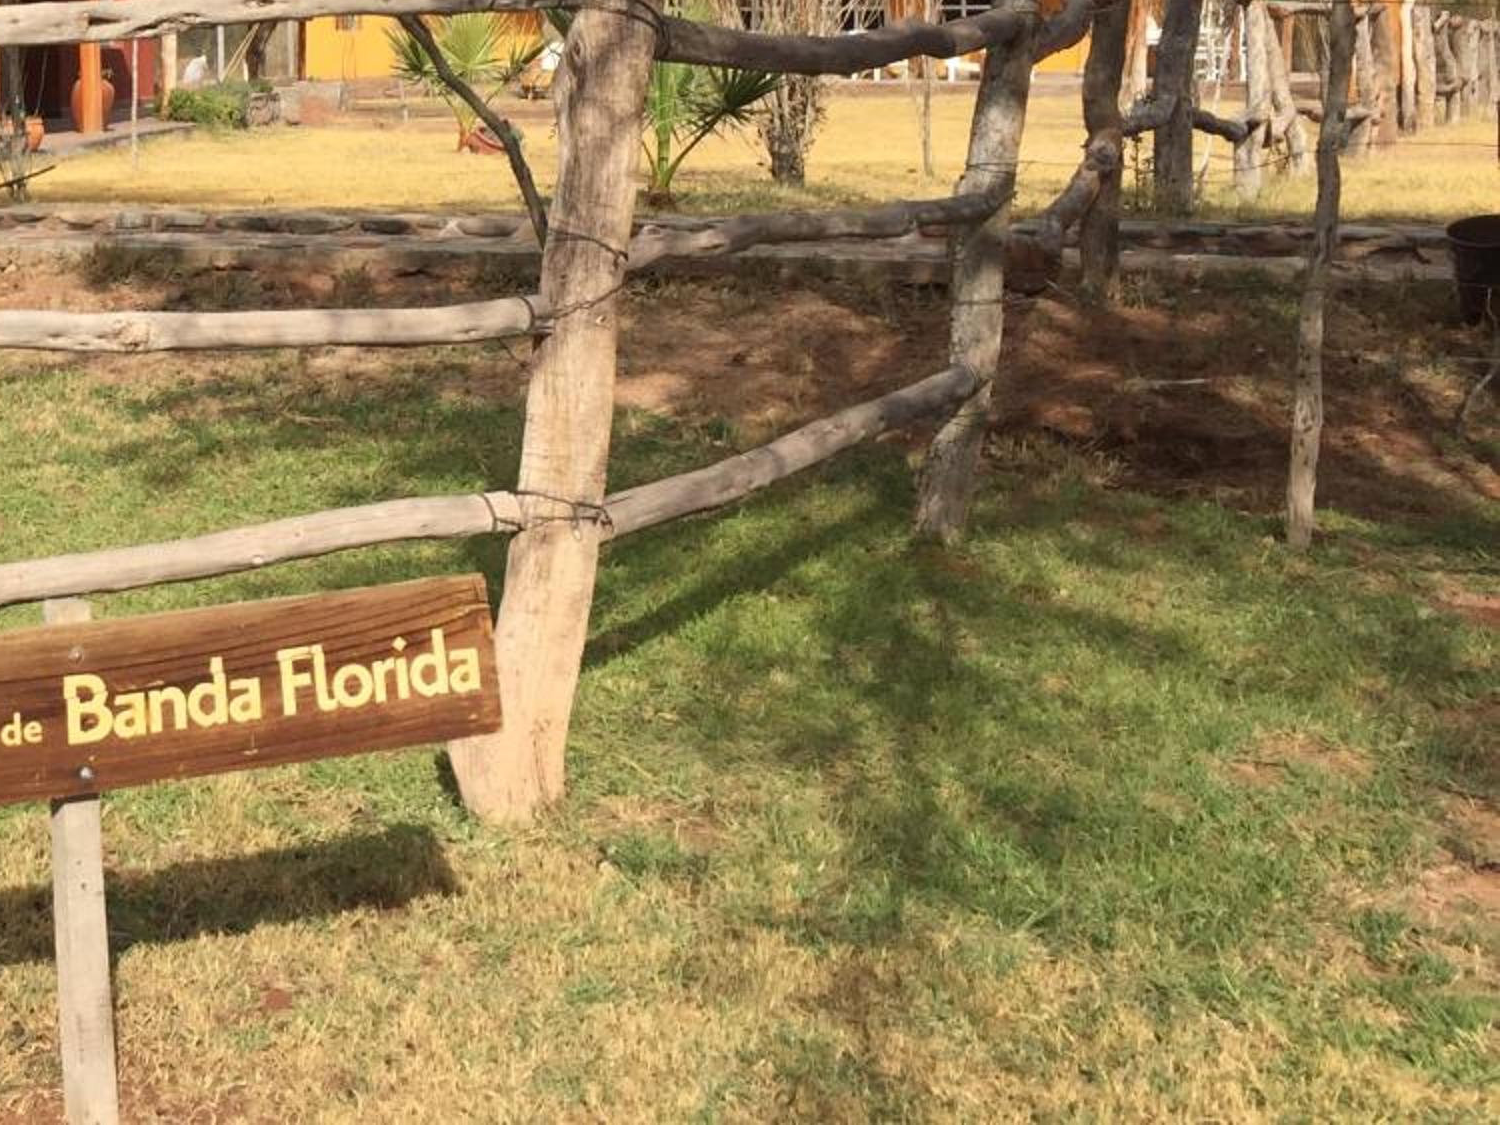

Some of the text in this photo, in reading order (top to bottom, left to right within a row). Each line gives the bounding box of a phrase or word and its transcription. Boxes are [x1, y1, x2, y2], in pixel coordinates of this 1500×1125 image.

[1, 712, 43, 747] de
[62, 658, 261, 746] Banda
[277, 628, 481, 717] Florida
